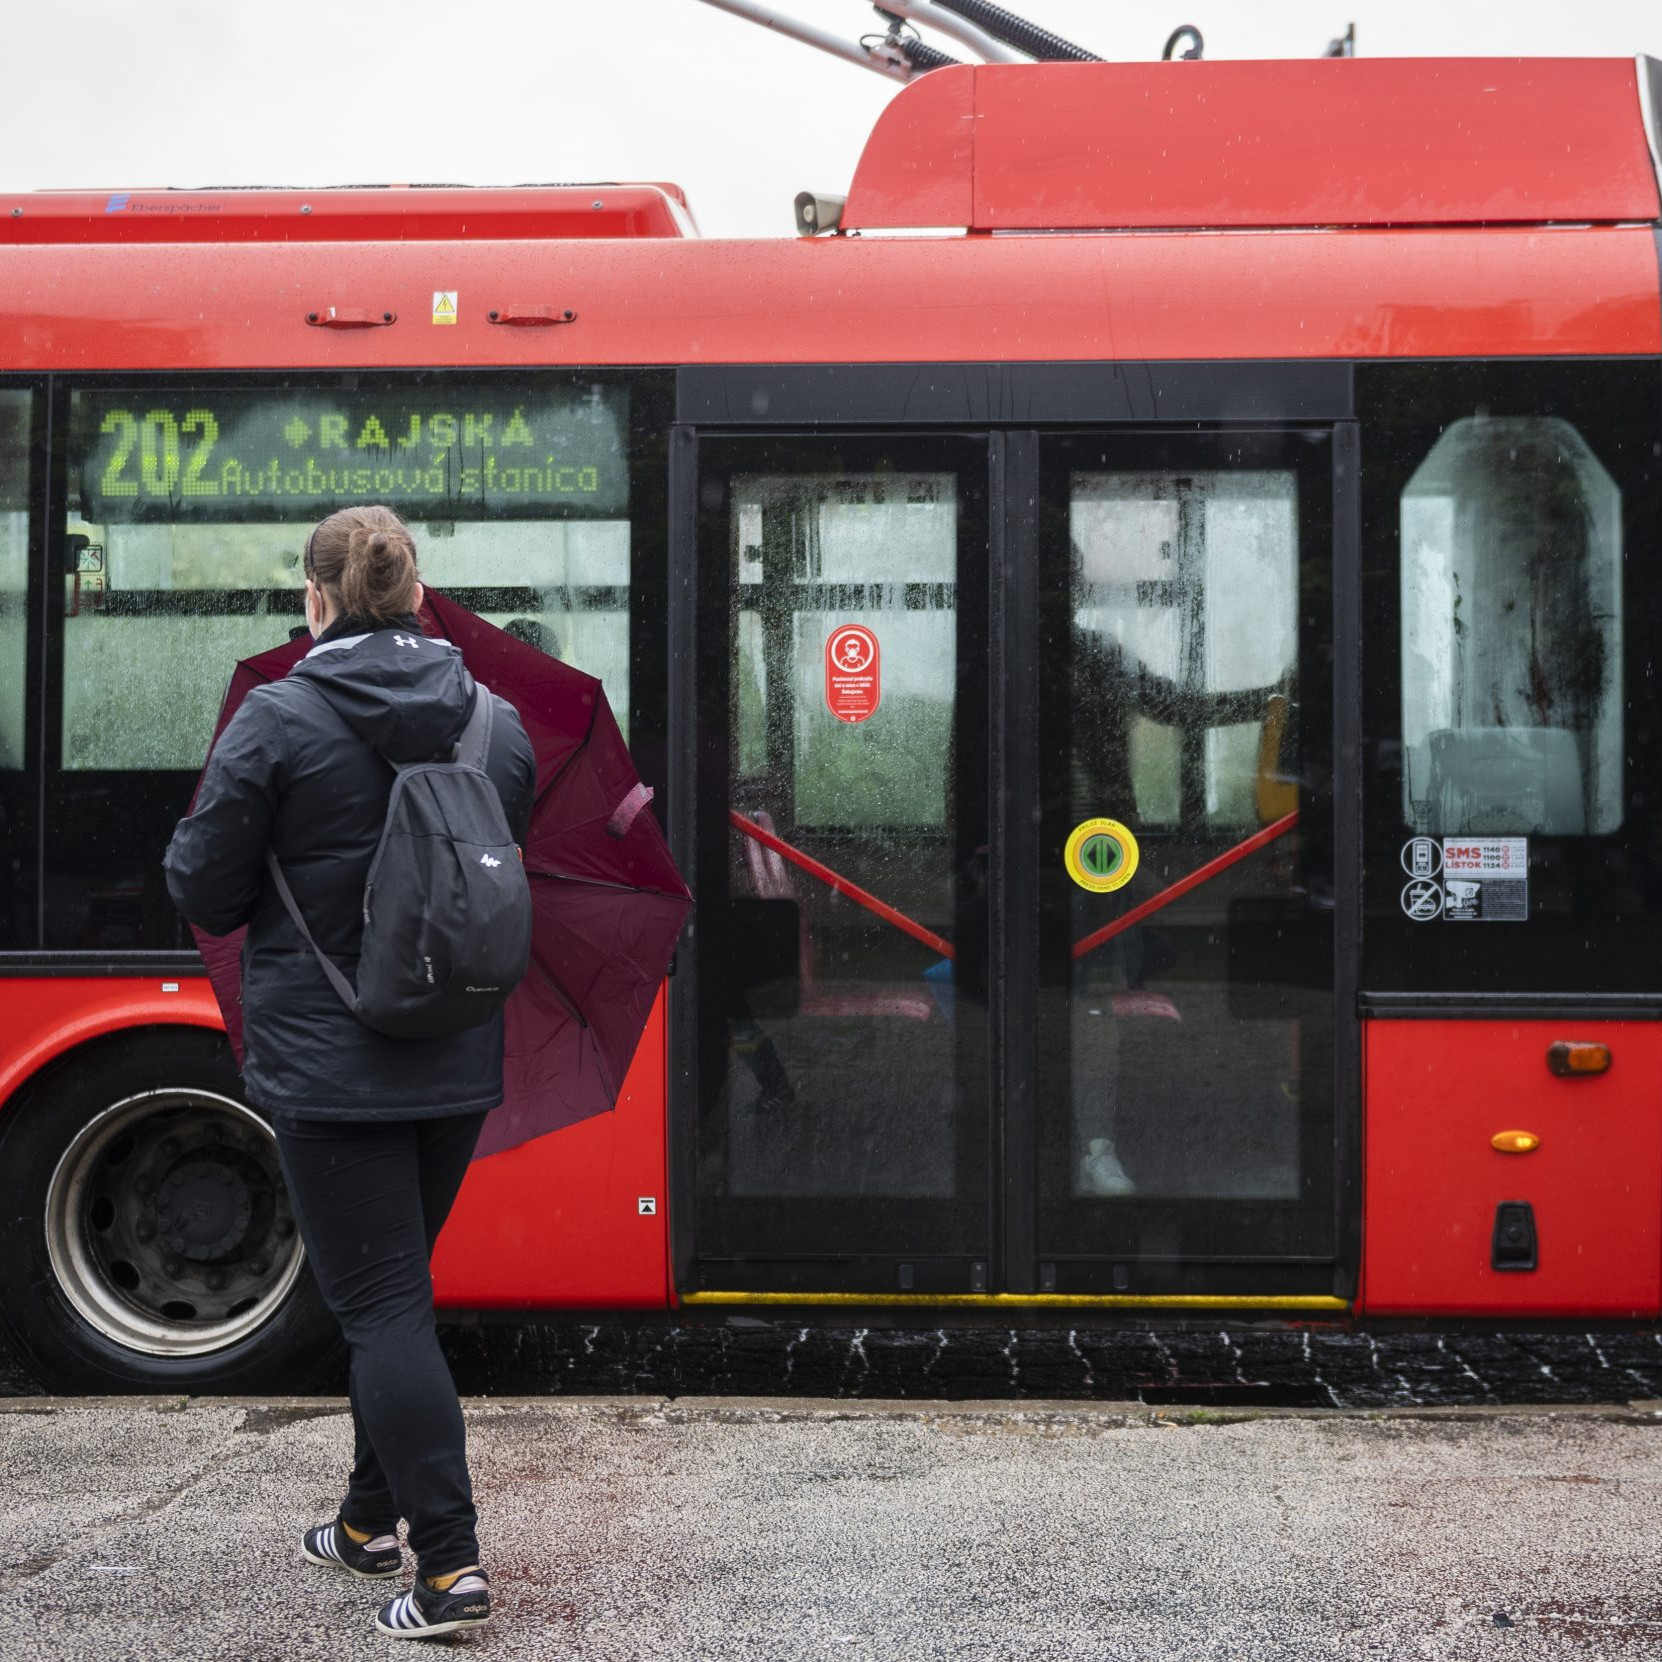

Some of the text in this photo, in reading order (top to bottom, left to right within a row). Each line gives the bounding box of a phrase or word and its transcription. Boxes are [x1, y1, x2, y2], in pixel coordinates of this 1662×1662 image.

[319, 405, 533, 448] RAJSKÁ
[101, 409, 219, 496] 202
[222, 453, 445, 495] Autobusová
[1446, 847, 1481, 859] SMS
